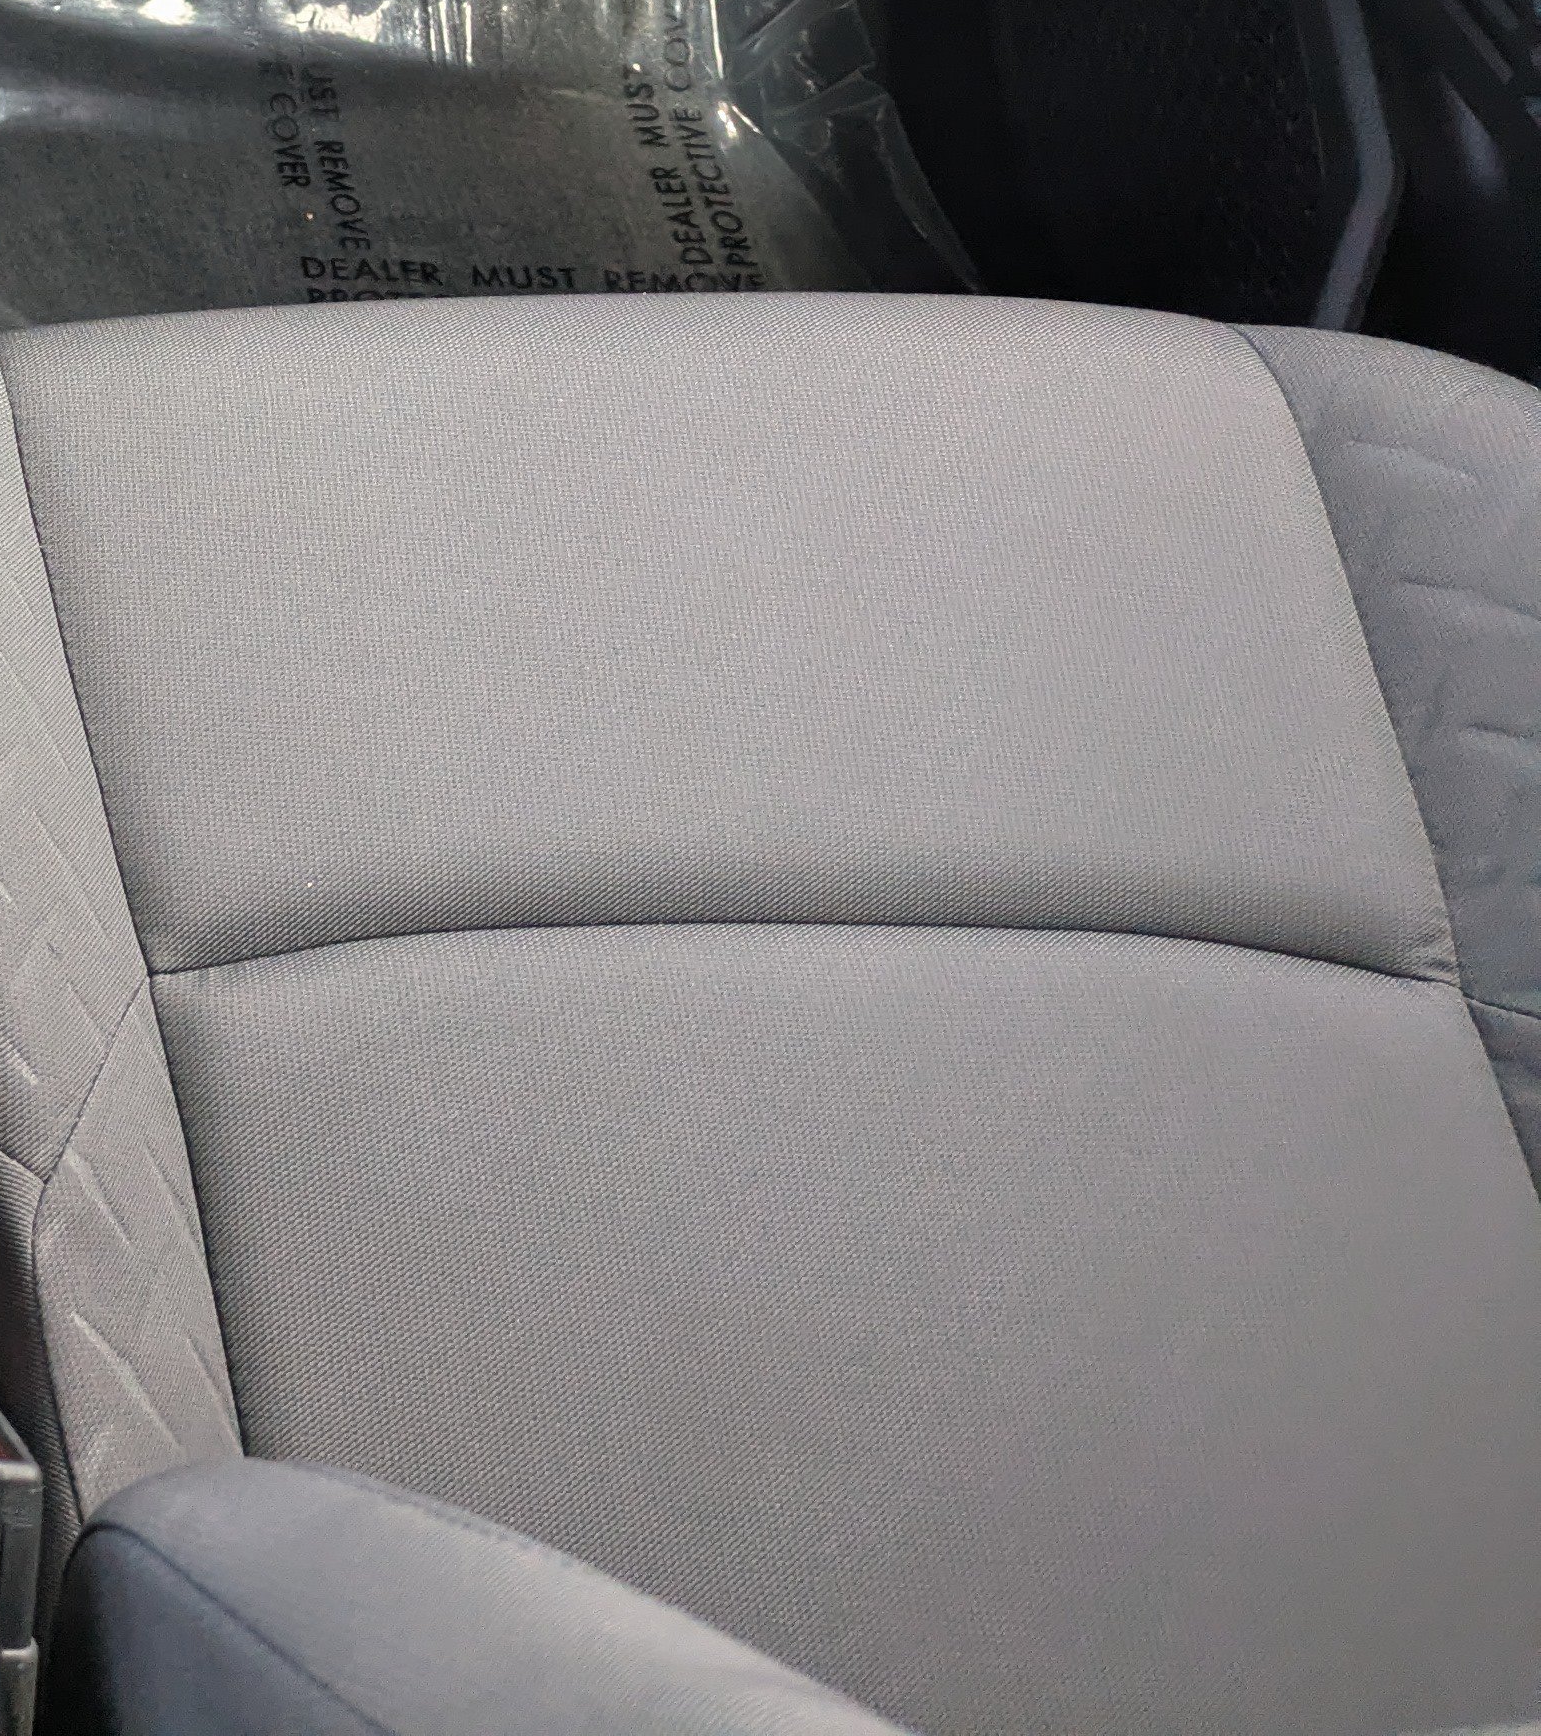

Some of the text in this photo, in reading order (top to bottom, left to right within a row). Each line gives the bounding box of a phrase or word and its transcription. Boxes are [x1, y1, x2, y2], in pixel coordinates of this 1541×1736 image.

[269, 91, 311, 188] COVER
[671, 106, 760, 267] PROTECTIVE
[314, 139, 371, 251] REMOVE
[650, 166, 714, 265] DEALER
[300, 256, 444, 287] DEALER
[471, 264, 577, 290] MUST
